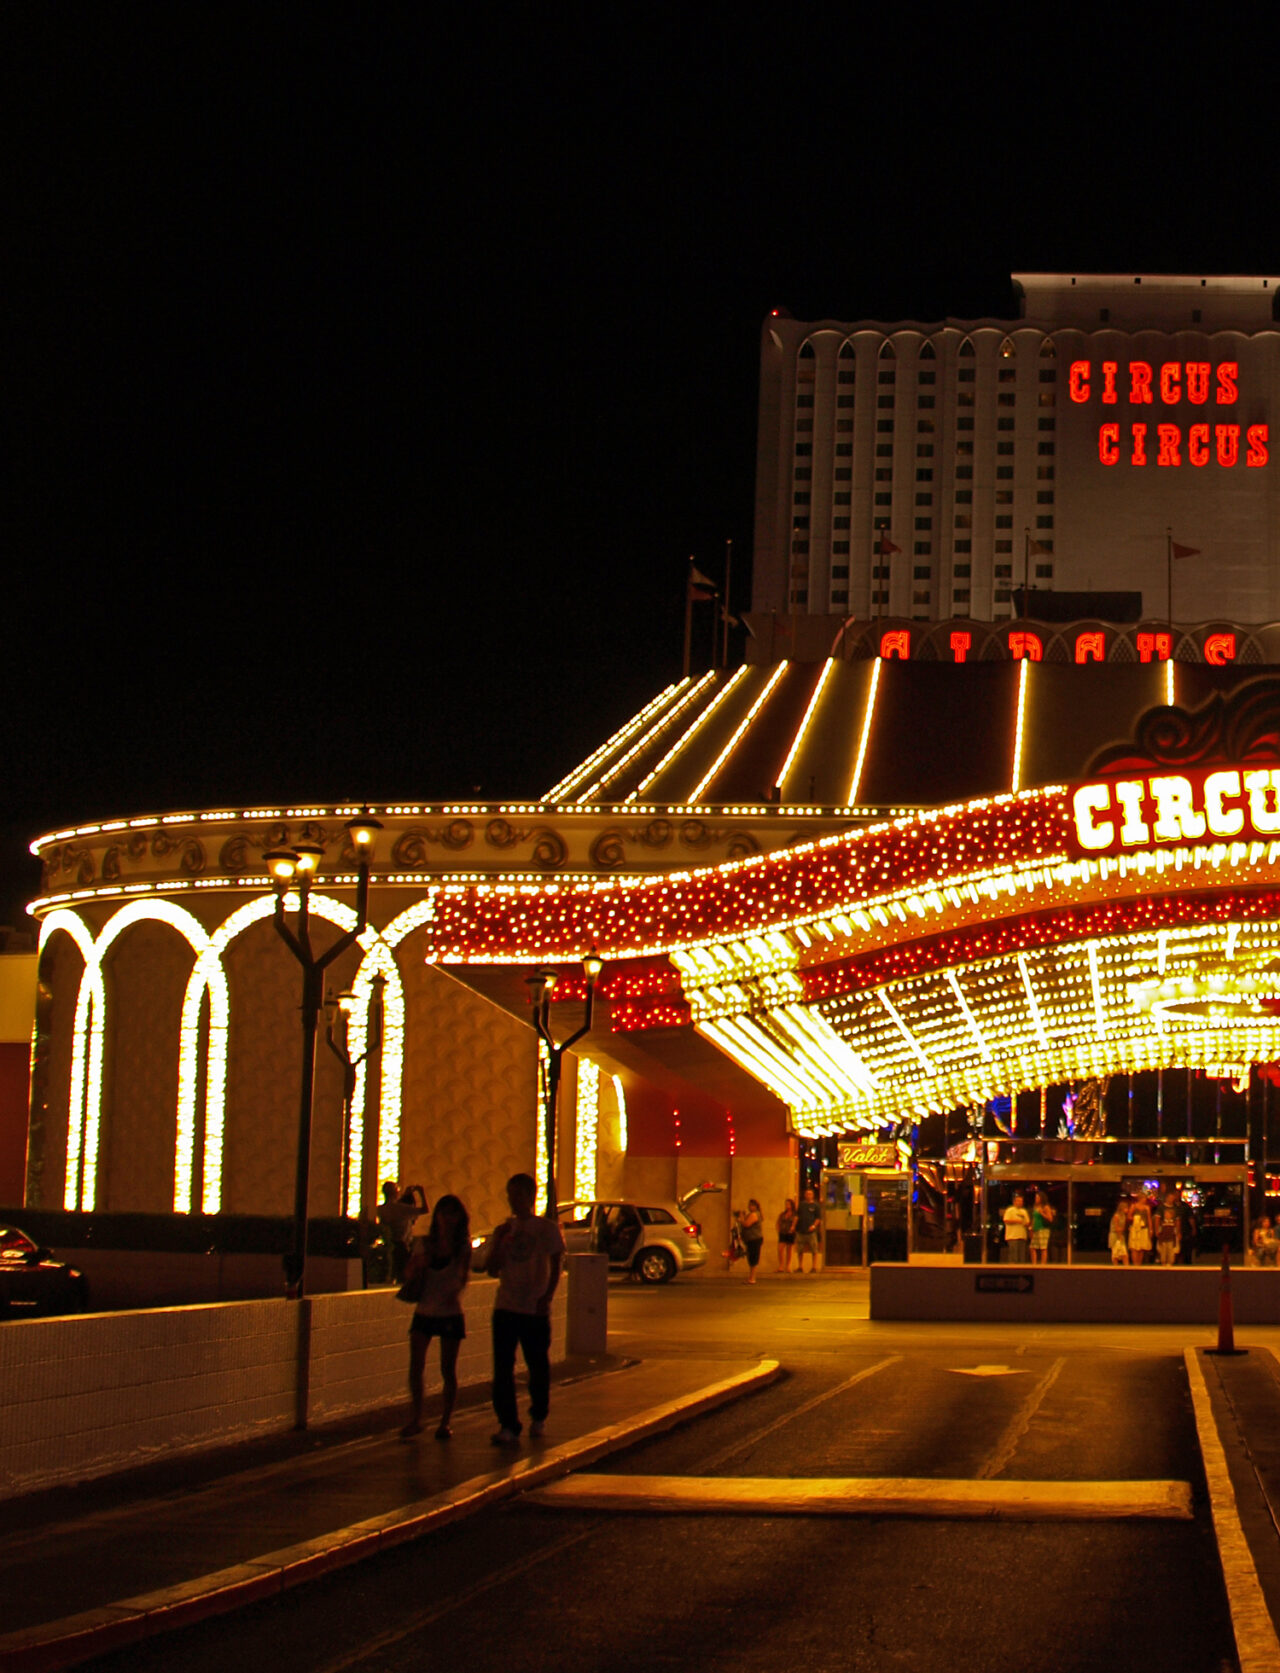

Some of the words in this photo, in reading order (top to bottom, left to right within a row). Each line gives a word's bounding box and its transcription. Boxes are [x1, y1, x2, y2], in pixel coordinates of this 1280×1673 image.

[1069, 360, 1239, 404] CIRCUS
[1099, 423, 1269, 467] CIRCUS
[843, 1147, 889, 1163] Valet
